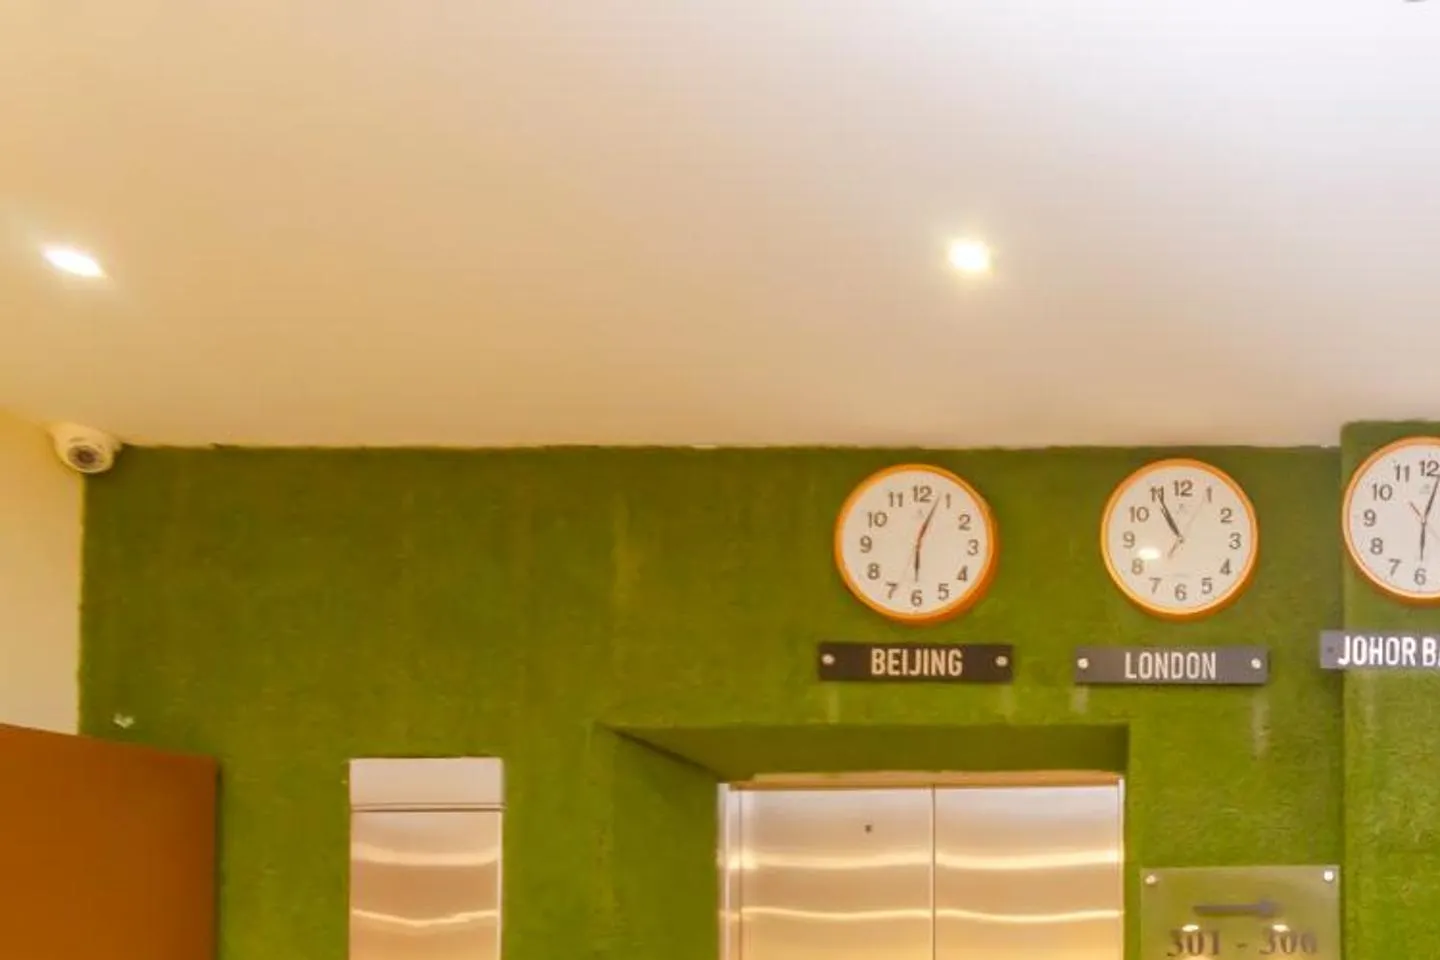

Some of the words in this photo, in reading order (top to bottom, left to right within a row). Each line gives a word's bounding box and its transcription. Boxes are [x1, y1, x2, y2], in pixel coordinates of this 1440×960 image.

[1394, 464, 1410, 482] 11
[1419, 460, 1440, 477] 12
[913, 485, 933, 502] 12
[1174, 480, 1193, 497] 12
[1372, 484, 1392, 501] 10
[888, 492, 903, 507] 11
[868, 512, 887, 528] 10
[959, 514, 971, 530] 2
[1129, 507, 1149, 522] 10
[1220, 508, 1232, 523] 2
[1363, 510, 1376, 527] 9
[860, 536, 872, 553] 9
[967, 539, 978, 555] 3
[1123, 531, 1135, 548] 9
[1229, 533, 1241, 549] 3
[1370, 538, 1383, 555] 8
[867, 563, 880, 580] 8
[957, 566, 967, 581] 4
[1131, 559, 1144, 575] 8
[1220, 559, 1231, 575] 4
[1389, 559, 1401, 576] 7
[1414, 568, 1426, 585] 6
[886, 582, 898, 599] 7
[938, 583, 949, 601] 5
[1149, 578, 1162, 594] 7
[1175, 584, 1187, 601] 6
[1202, 578, 1212, 594] 5
[910, 590, 922, 607] 6
[1337, 635, 1417, 666] JOHOR
[871, 648, 963, 677] BEIJING
[1124, 651, 1217, 680] LONDON
[1167, 928, 1220, 956] 301
